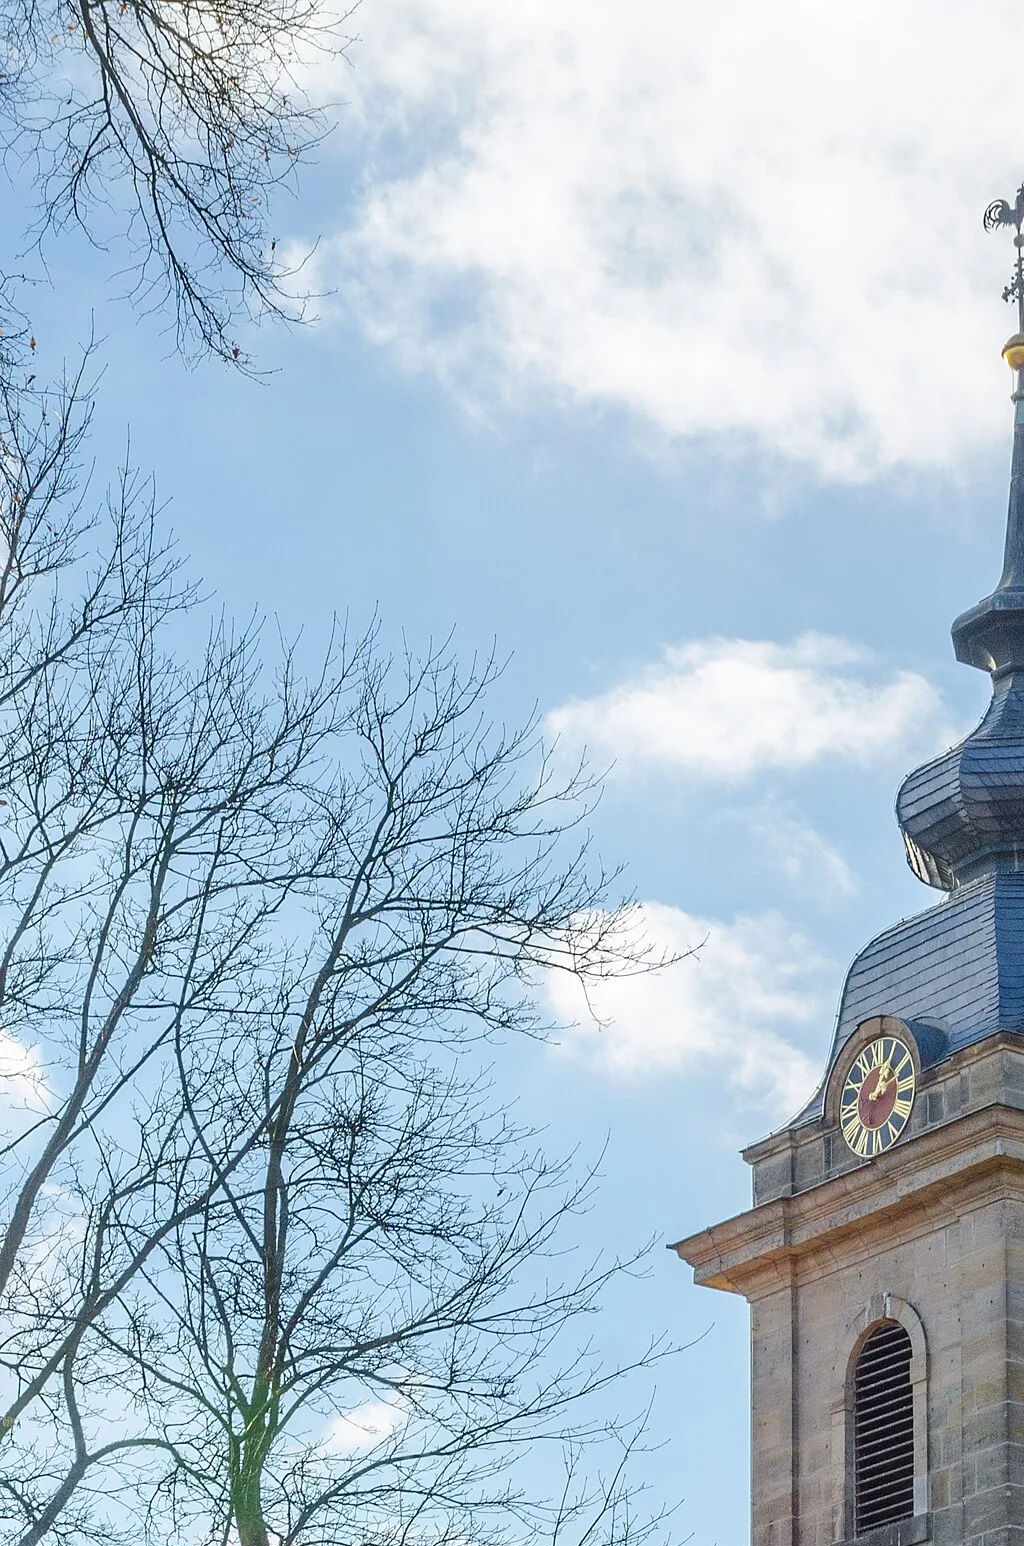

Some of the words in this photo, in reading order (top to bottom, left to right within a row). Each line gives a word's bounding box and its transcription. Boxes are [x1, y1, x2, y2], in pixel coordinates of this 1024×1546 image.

[894, 1052, 910, 1074] II
[845, 1079, 861, 1092] X
[887, 1121, 899, 1141] V
